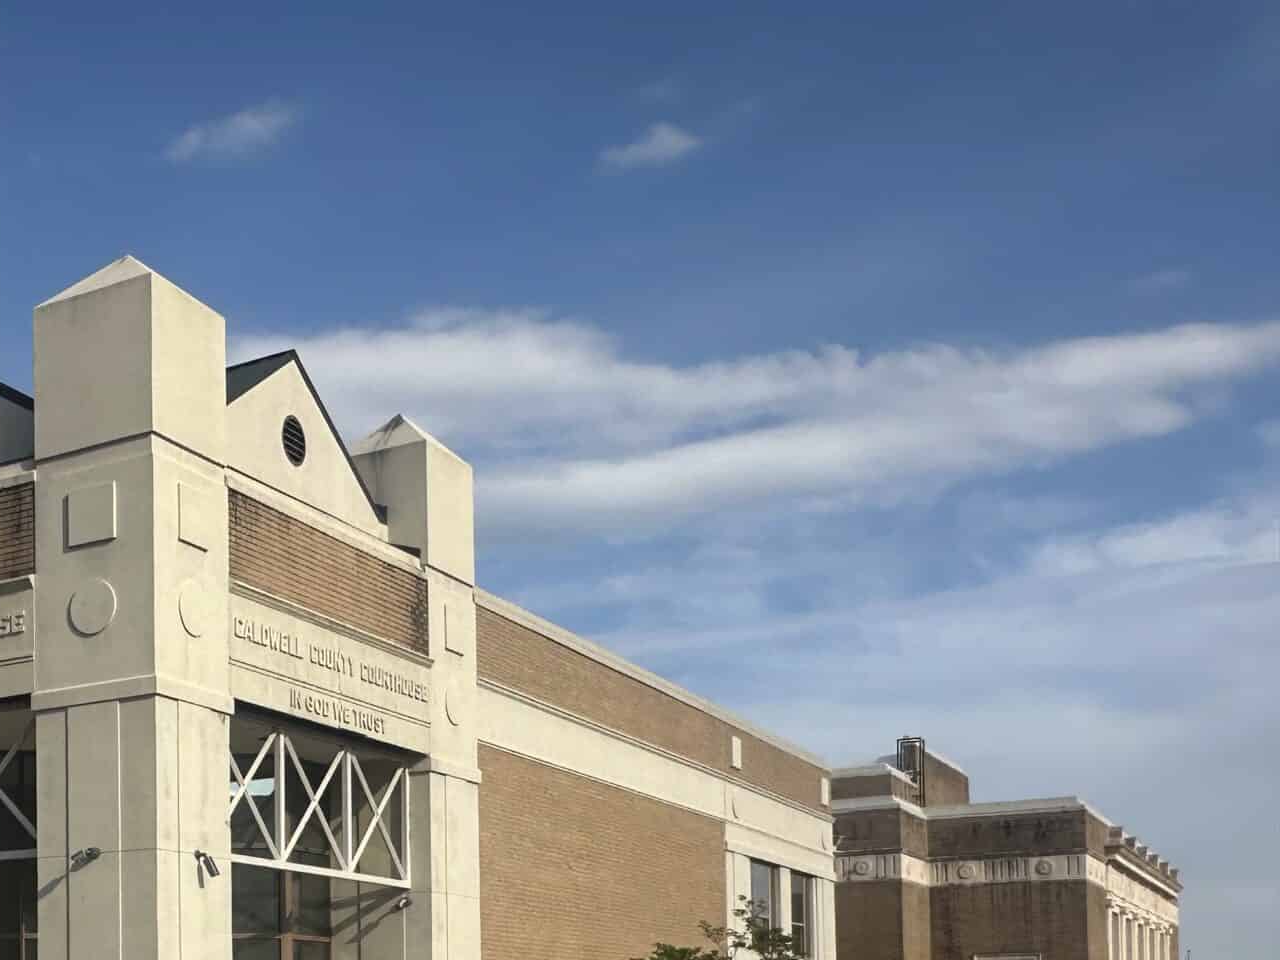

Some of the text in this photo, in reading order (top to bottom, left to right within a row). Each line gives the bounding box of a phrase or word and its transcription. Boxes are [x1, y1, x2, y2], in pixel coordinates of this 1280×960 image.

[234, 616, 429, 703] CALDWELL COUNTY COURTHOUSE
[289, 687, 386, 736] IN GOD WE TRUST
